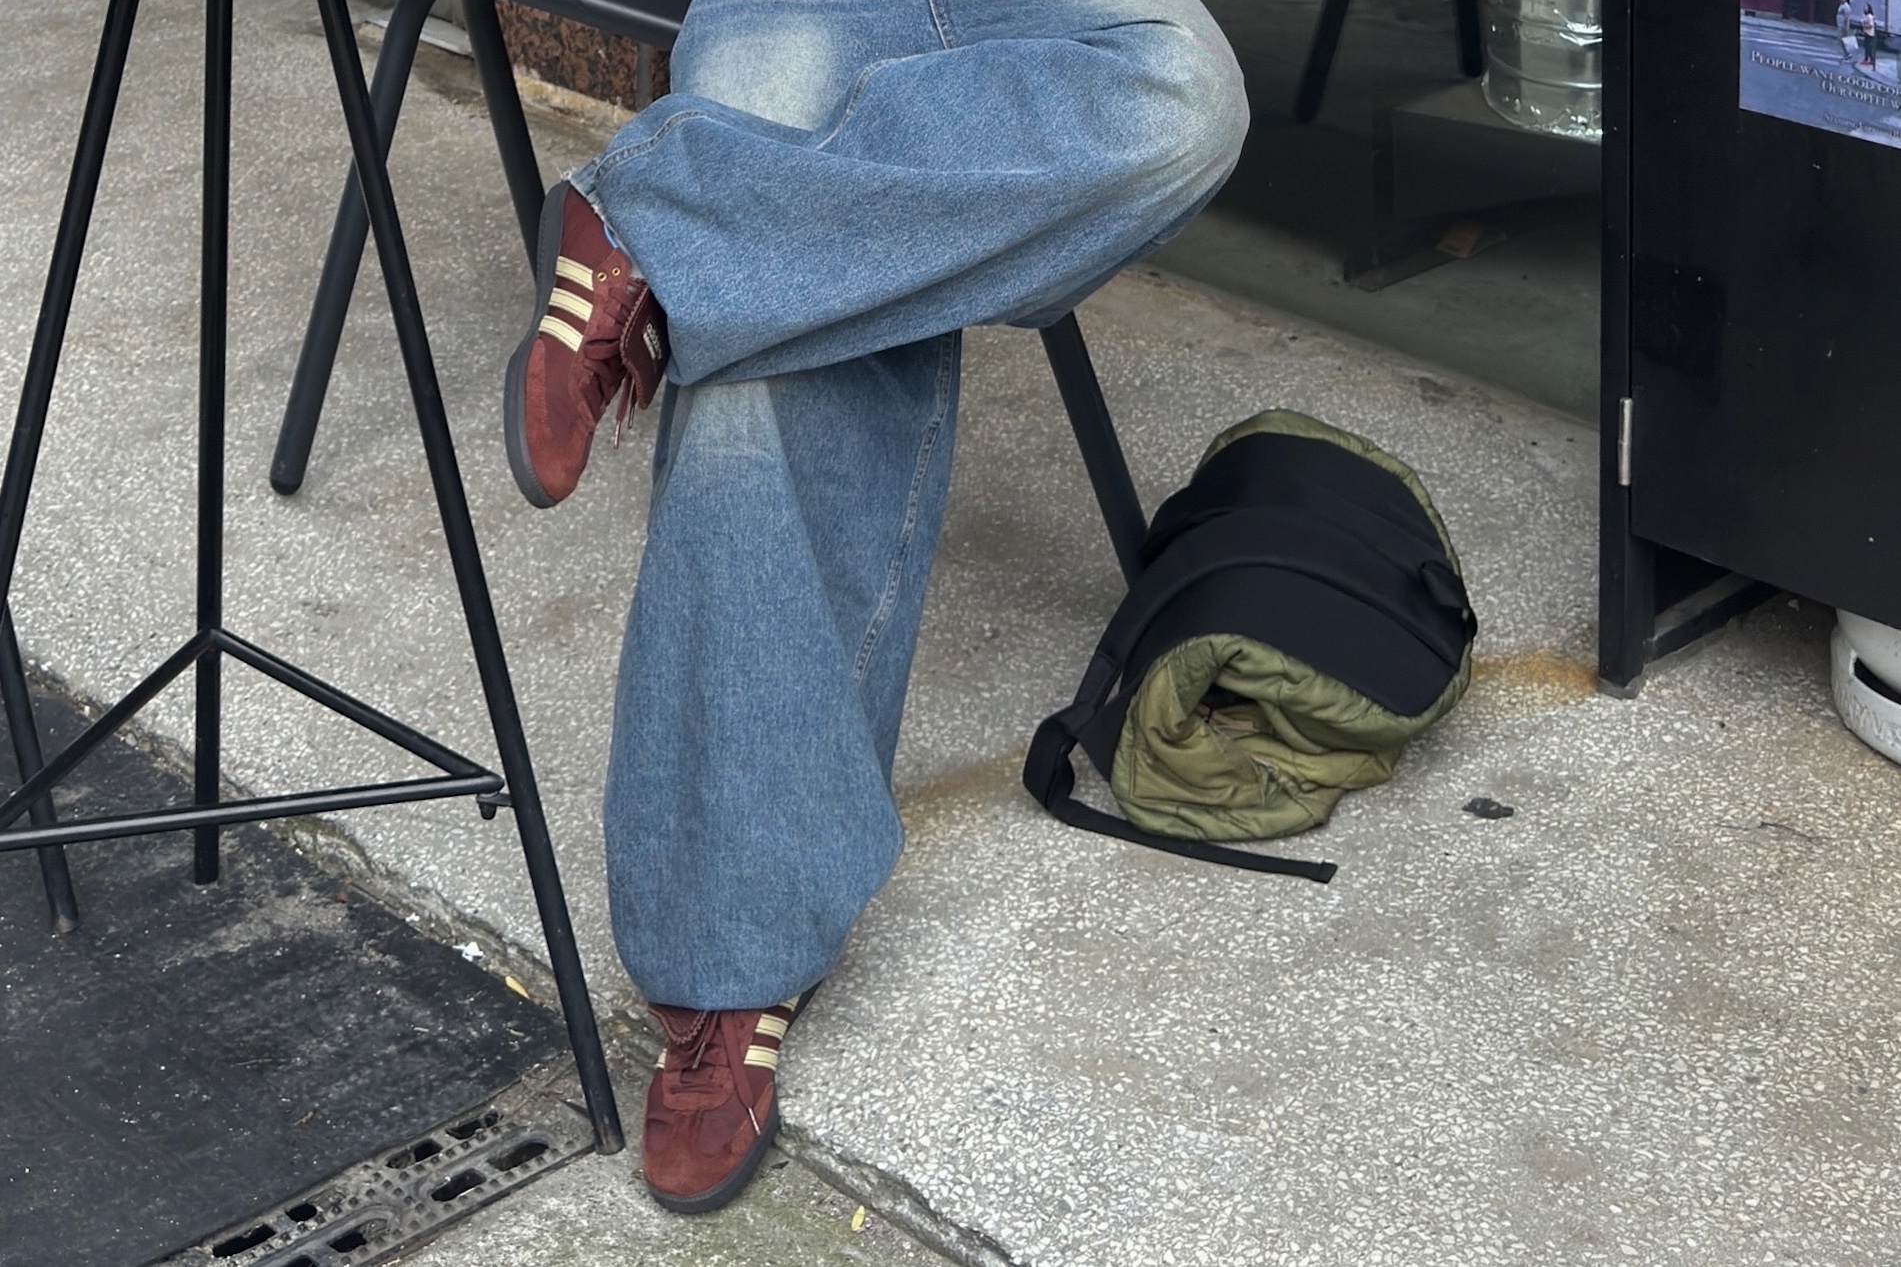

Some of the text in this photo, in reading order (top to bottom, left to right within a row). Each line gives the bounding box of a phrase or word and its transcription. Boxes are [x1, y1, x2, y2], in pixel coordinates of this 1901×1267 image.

[1751, 49, 1797, 72] PEOPLE
[1799, 64, 1835, 80] WANT
[1838, 74, 1876, 90] GOOD
[1821, 79, 1847, 97] OUR
